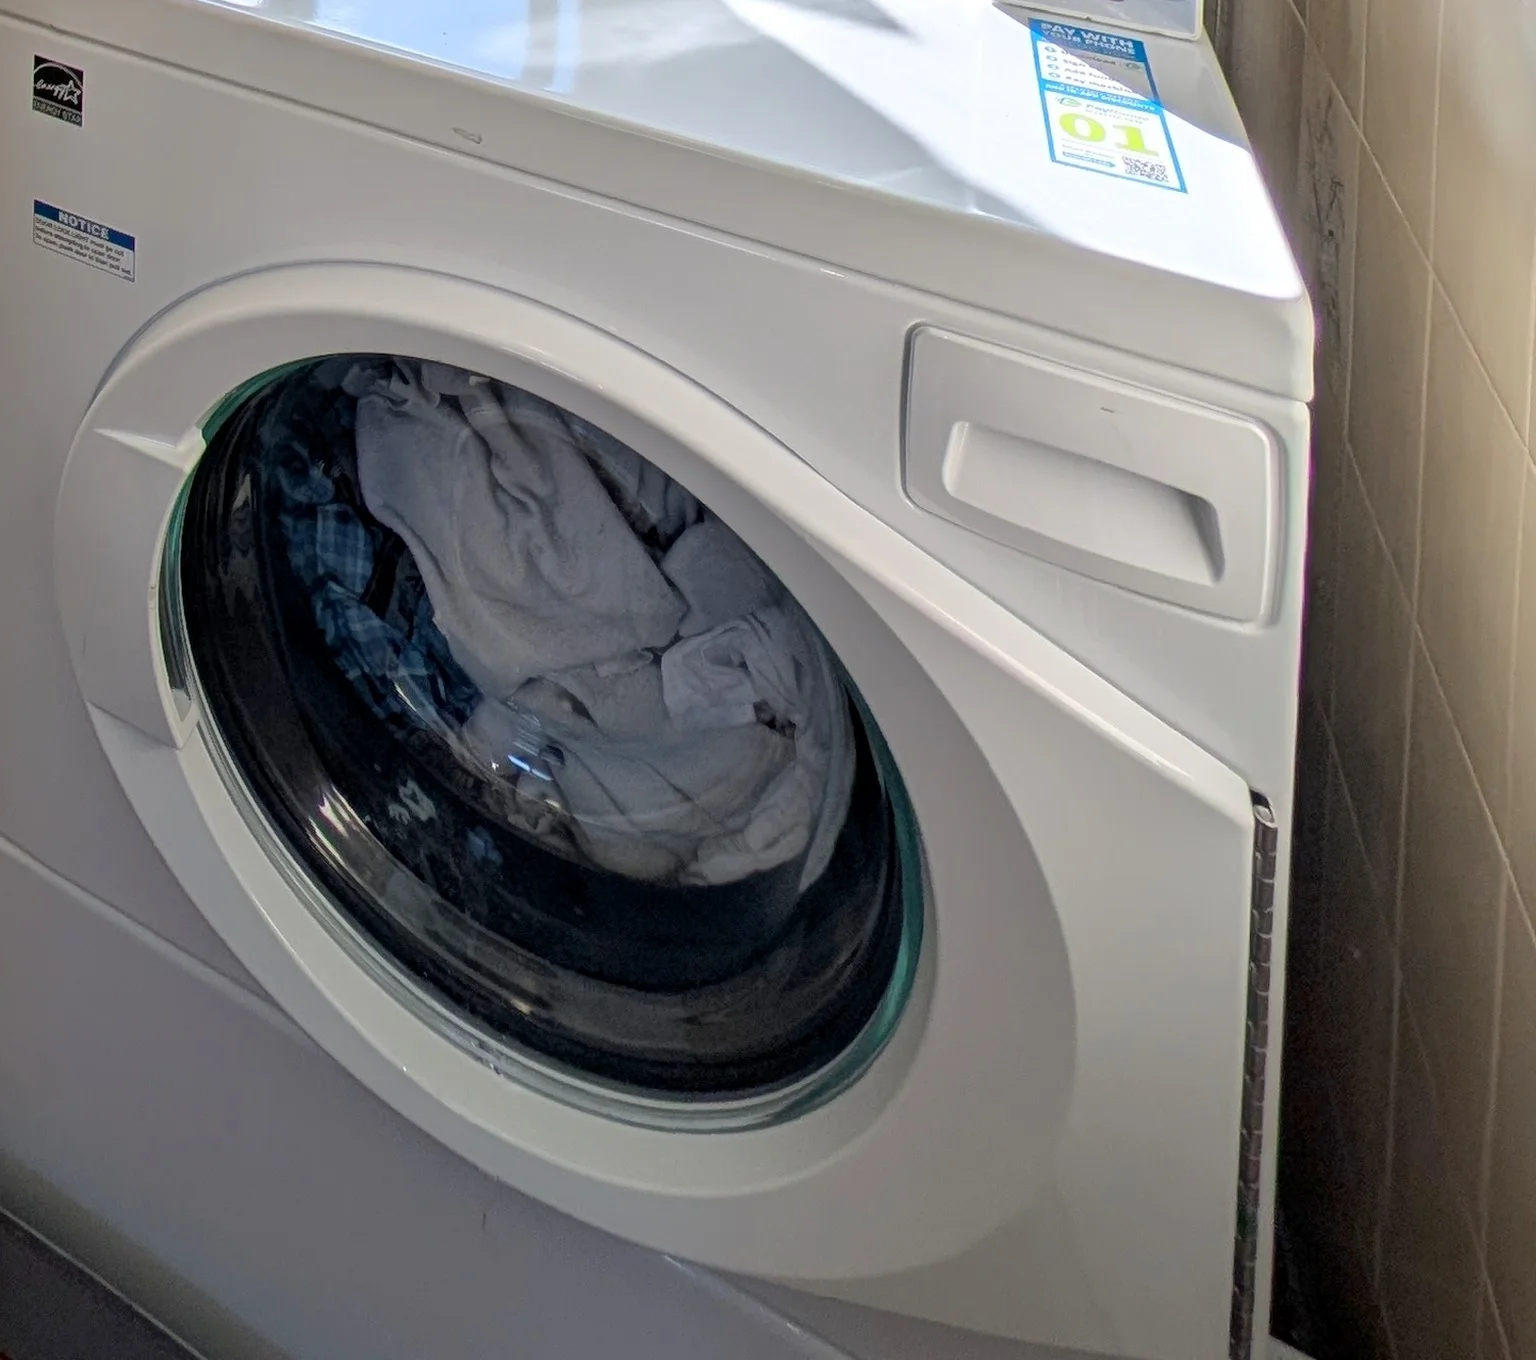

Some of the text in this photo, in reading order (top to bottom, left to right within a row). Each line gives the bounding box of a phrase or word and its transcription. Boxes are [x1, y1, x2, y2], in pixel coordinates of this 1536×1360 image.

[1041, 23, 1134, 48] PAY WITH
[1059, 113, 1160, 157] 01
[58, 210, 109, 240] NOTICE
